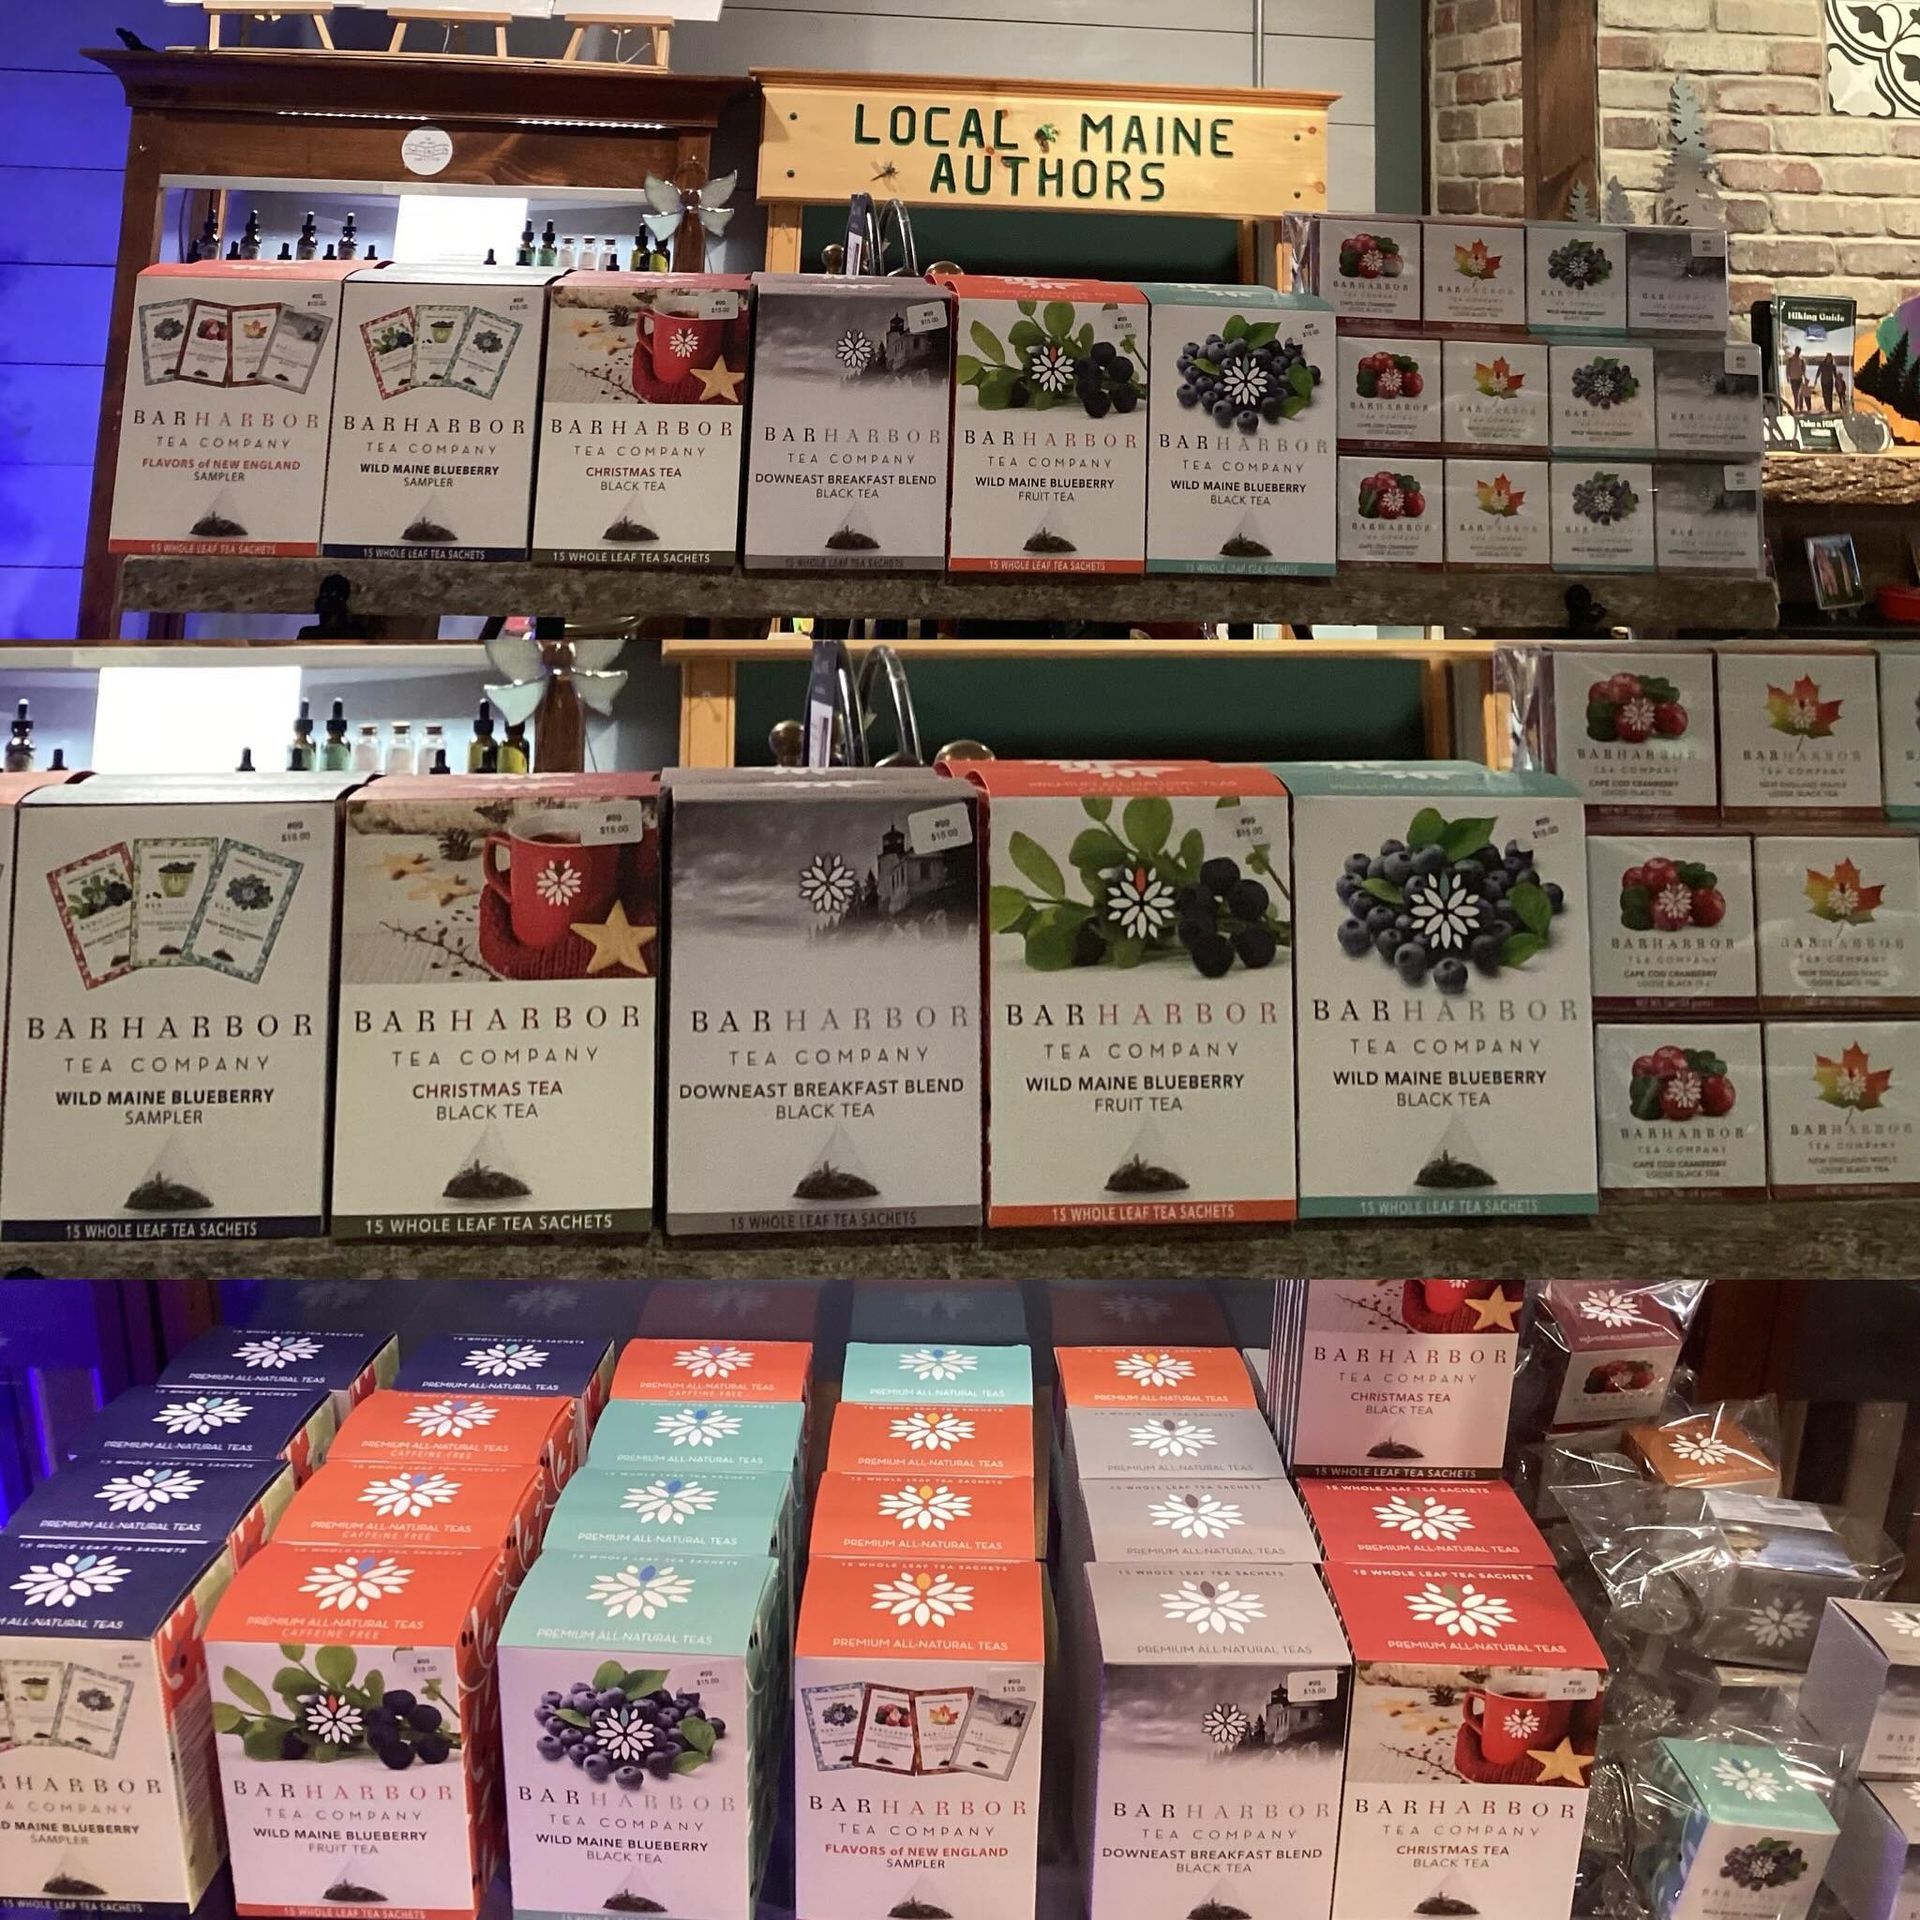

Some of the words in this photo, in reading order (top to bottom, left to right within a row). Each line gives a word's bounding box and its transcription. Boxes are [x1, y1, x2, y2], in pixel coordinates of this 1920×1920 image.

[854, 103, 1019, 150] LOCAL
[1080, 113, 1235, 158] MAINE
[930, 154, 1166, 201] AUTHORS
[1788, 312, 1817, 321] Hiking
[1819, 313, 1845, 322] Guide
[142, 458, 195, 469] FLAVORS
[198, 459, 210, 469] of
[213, 460, 240, 470] NEW
[243, 460, 301, 471] ENGLAND
[361, 464, 390, 474] WILD
[393, 464, 430, 475] MAINE
[434, 465, 500, 476] BLUEBERRY
[194, 472, 245, 482] SAMPLER
[586, 467, 656, 477] CHRISTMAS
[660, 468, 682, 477] TEA
[404, 477, 454, 488] SAMPLER
[601, 481, 640, 491] BLACK
[643, 482, 666, 491] TEA
[755, 474, 825, 485] DOWNEAST
[828, 475, 894, 485] BREAKFAST
[899, 475, 937, 486] BLEND
[975, 477, 1005, 487] WILD
[1008, 478, 1047, 488] MAINE
[1050, 478, 1115, 489] BLUEBERRY
[1171, 480, 1200, 490] WILD
[1203, 481, 1240, 492] MAINE
[1244, 482, 1306, 493] BLUEBERRY
[816, 489, 854, 499] BLACK
[857, 489, 879, 499] TEA
[1019, 492, 1050, 501] FRUIT
[1053, 492, 1075, 502] TEA
[1210, 495, 1247, 505] BLACK
[1250, 496, 1271, 505] TEA
[1044, 1044, 1091, 1061] TEA
[1108, 1042, 1239, 1060] COMPANY
[1351, 1039, 1397, 1055] TEA
[1413, 1039, 1542, 1055] COMPANY
[392, 1051, 441, 1068] TEA
[460, 1046, 599, 1066] COMPANY
[729, 1051, 777, 1066] TEA
[796, 1046, 929, 1065] COMPANY
[65, 1057, 112, 1074] TEA
[131, 1056, 270, 1073] COMPANY
[1026, 1077, 1072, 1092] WILD
[1078, 1076, 1138, 1091] MAINE
[1144, 1074, 1245, 1090] BLUEBERRY
[1333, 1071, 1379, 1086] WILD
[1385, 1071, 1442, 1085] MAINE
[1449, 1070, 1547, 1085] BLUEBERRY
[412, 1082, 521, 1099] CHRISTMAS
[527, 1081, 563, 1096] TEA
[679, 1084, 787, 1099] DOWNEAST
[794, 1080, 899, 1098] BREAKFAST
[905, 1078, 964, 1095] BLEND
[56, 1091, 102, 1106] WILD
[107, 1090, 166, 1106] MAINE
[172, 1088, 275, 1105] BLUEBERRY
[1397, 1092, 1453, 1107] BLACK
[1458, 1092, 1491, 1106] TEA
[776, 1104, 835, 1120] BLACK
[840, 1103, 875, 1118] TEA
[1095, 1098, 1143, 1113] FRUIT
[1149, 1097, 1183, 1112] TEA
[125, 1110, 203, 1125] SAMPLER
[437, 1105, 498, 1121] BLACK
[504, 1104, 538, 1119] TEA
[366, 1220, 383, 1233] 15
[390, 1217, 450, 1233] WHOLE
[457, 1216, 497, 1232] LEAF
[502, 1215, 532, 1231] TEA
[539, 1214, 613, 1231] SACHETS
[189, 1373, 235, 1381] PREMIUM
[301, 1375, 325, 1384] TEAS
[1339, 1373, 1371, 1383] TEA
[1384, 1373, 1478, 1385] COMPANY
[1350, 1392, 1424, 1403] CHRISTMAS
[1428, 1393, 1451, 1403] TEA
[1366, 1405, 1406, 1415] BLACK
[1410, 1406, 1433, 1415] TEA
[833, 1638, 890, 1649] PREMIUM
[893, 1639, 974, 1650] ALL-NATURAL
[978, 1641, 1009, 1651] TEAS
[1388, 1640, 1446, 1649] PREMIUM
[1450, 1641, 1532, 1653] ALL-NATURAL
[1536, 1644, 1567, 1653] TEAS
[266, 1808, 301, 1819] TEA
[316, 1809, 422, 1821] COMPANY
[549, 1814, 586, 1826] TEA
[600, 1817, 705, 1832] COMPANY
[253, 1828, 290, 1839] WILD
[294, 1829, 342, 1840] MAINE
[346, 1831, 428, 1842] BLUEBERRY
[839, 1823, 876, 1835] TEA
[890, 1826, 995, 1837] COMPANY
[1142, 1829, 1179, 1839] TEA
[1193, 1830, 1298, 1840] COMPANY
[1384, 1825, 1420, 1835] TEA
[1434, 1825, 1540, 1837] COMPANY
[309, 1843, 348, 1854] FRUIT
[352, 1844, 379, 1854] TEA
[536, 1833, 572, 1845] WILD
[576, 1836, 623, 1848] MAINE
[628, 1839, 709, 1852] BLUEBERRY
[587, 1850, 632, 1862] BLACK
[636, 1853, 663, 1864] TEA
[825, 1844, 886, 1856] FLAVORS
[890, 1847, 904, 1855] of
[908, 1847, 939, 1857] NEW
[943, 1847, 1009, 1857] ENGLAND
[1102, 1848, 1185, 1860] DOWNEAST
[1190, 1850, 1271, 1860] BREAKFAST
[1276, 1849, 1323, 1859] BLEND
[1397, 1845, 1479, 1855] CHRISTMAS
[1483, 1846, 1510, 1856] TEA
[887, 1859, 946, 1869] SAMPLER
[1177, 1863, 1221, 1873] BLACK
[1226, 1863, 1253, 1873] TEA
[1413, 1858, 1459, 1868] BLACK
[1464, 1859, 1490, 1868] TEA
